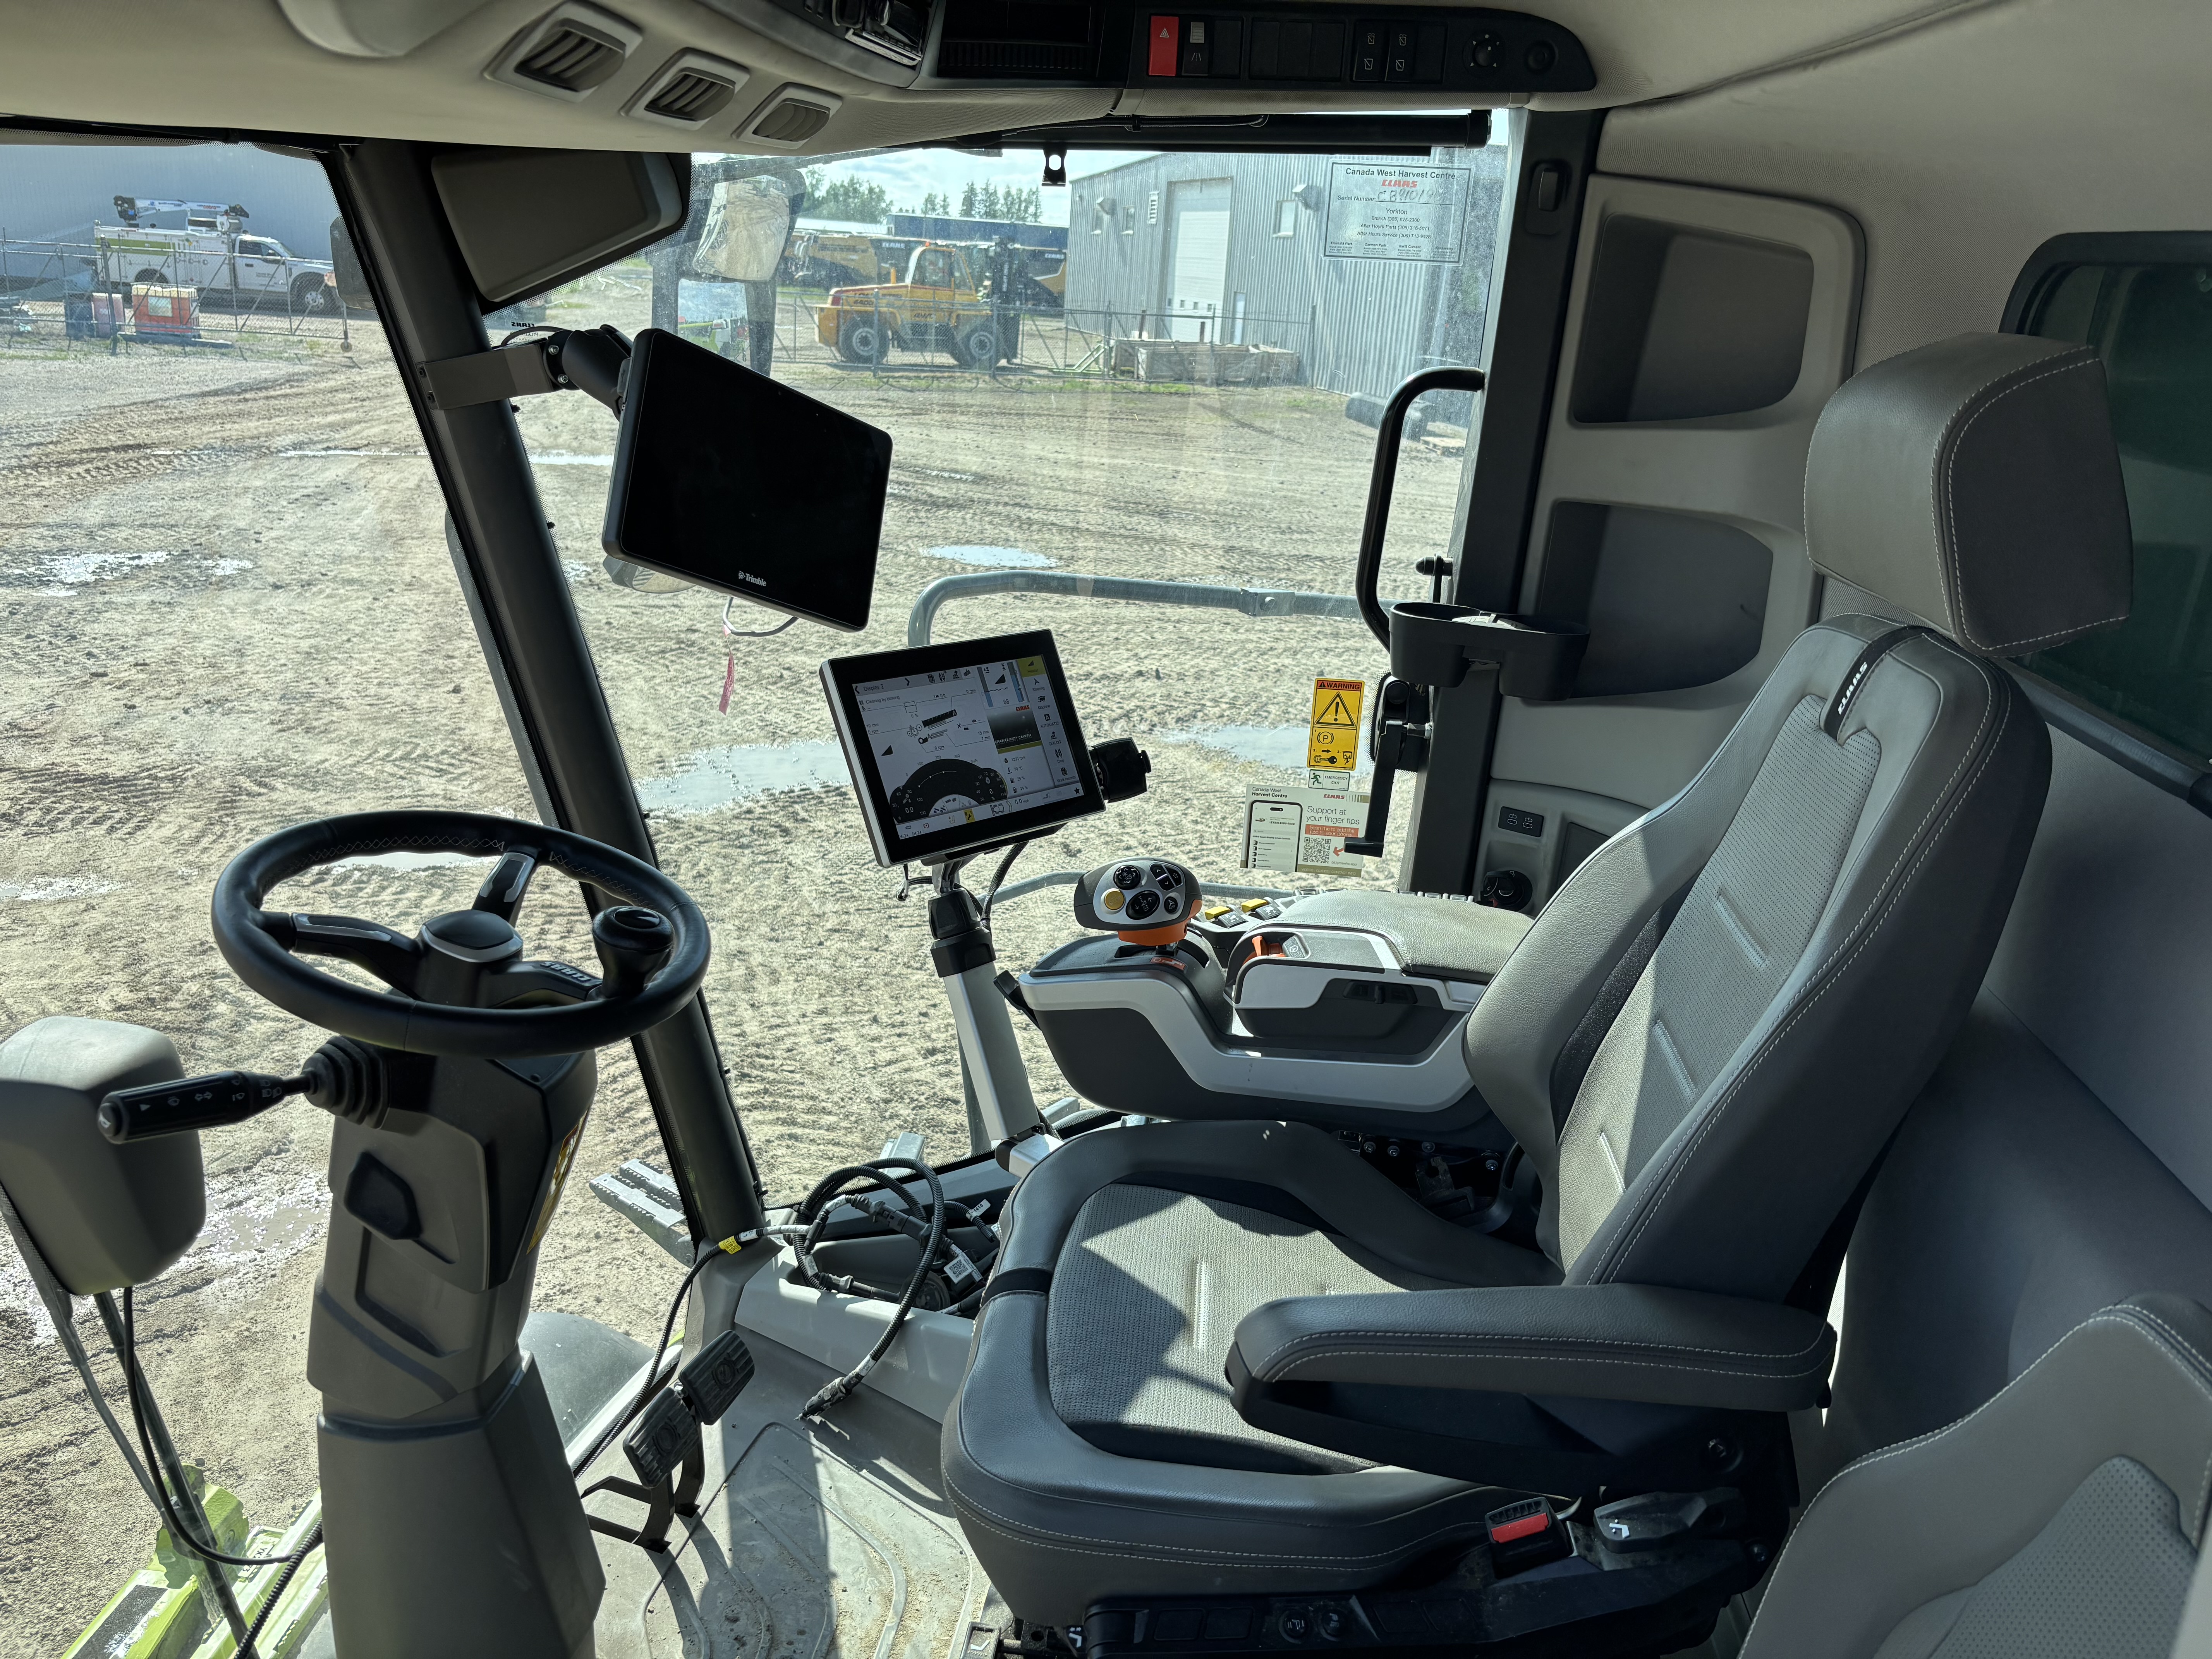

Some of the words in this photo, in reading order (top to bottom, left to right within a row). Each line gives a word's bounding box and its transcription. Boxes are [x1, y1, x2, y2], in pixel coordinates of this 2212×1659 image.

[1381, 179, 1418, 188] CLAAS
[745, 573, 767, 587] Trimble
[1838, 661, 1868, 715] CLAAS
[1307, 805, 1337, 815] Support
[1324, 815, 1345, 824] finger
[1347, 817, 1360, 825] tips
[540, 961, 592, 981] CLAAS
